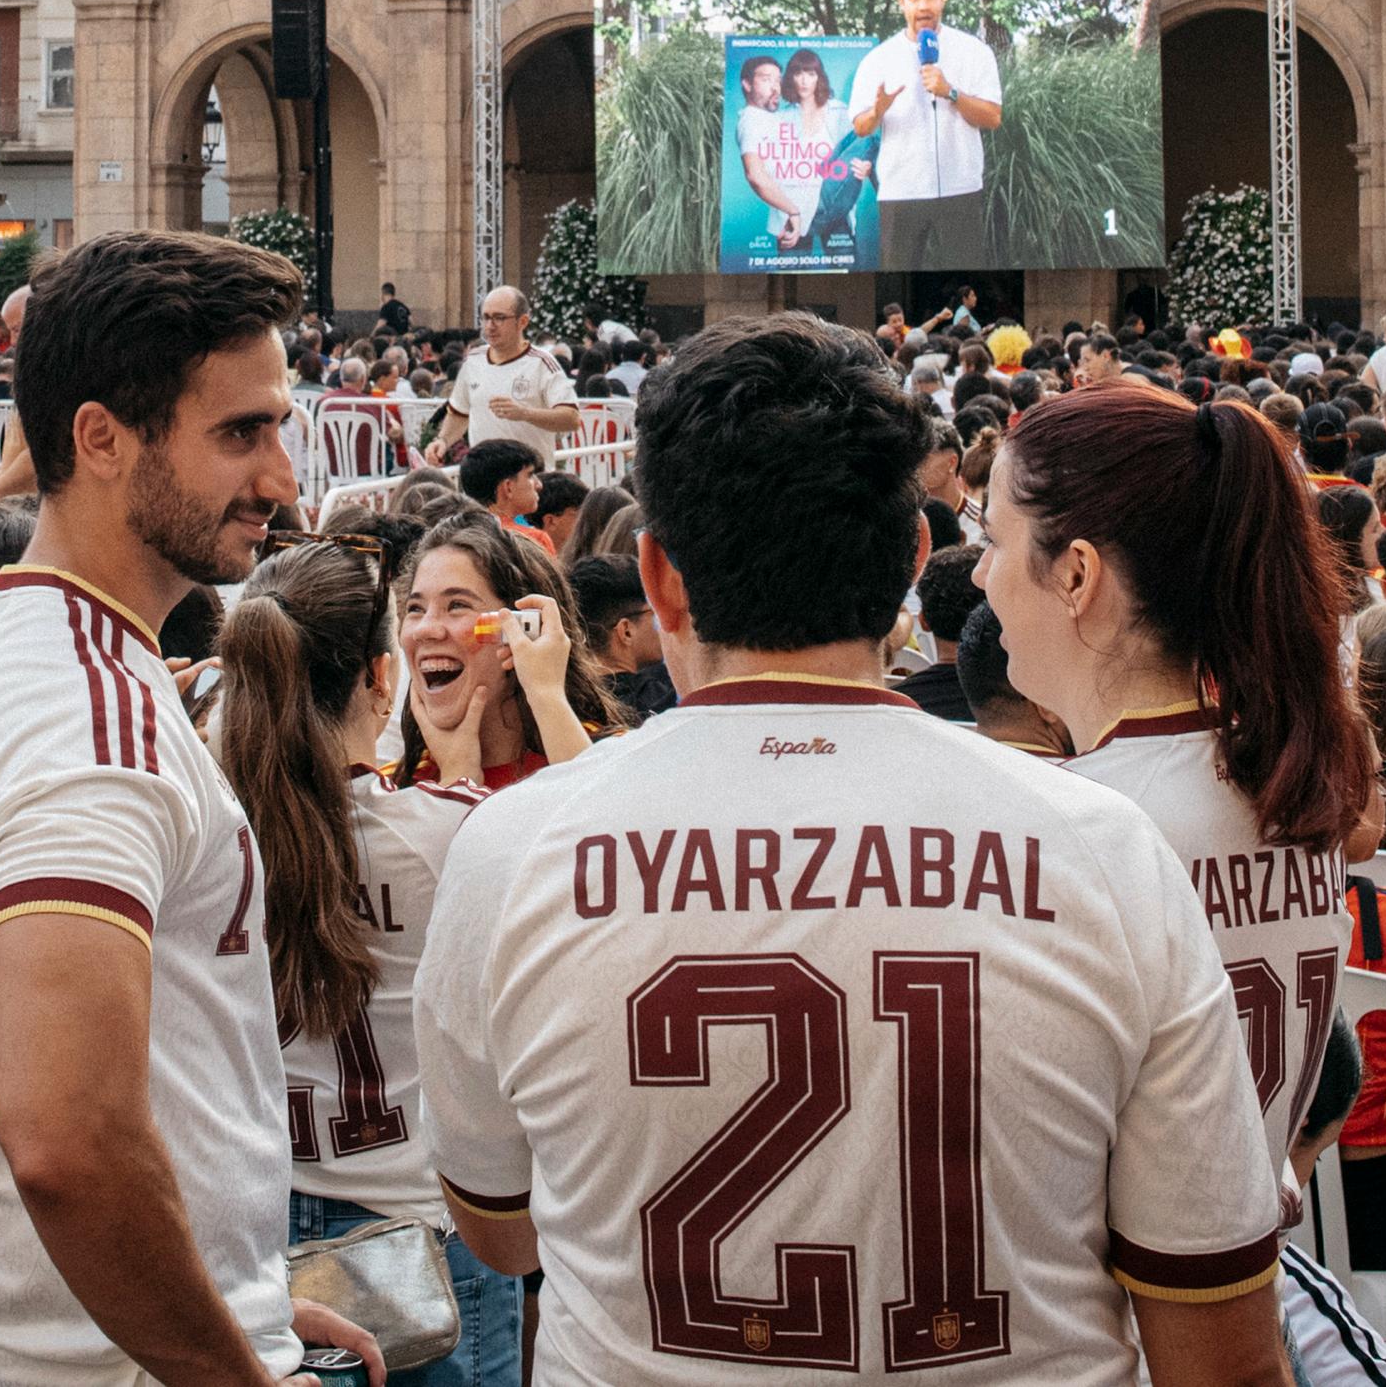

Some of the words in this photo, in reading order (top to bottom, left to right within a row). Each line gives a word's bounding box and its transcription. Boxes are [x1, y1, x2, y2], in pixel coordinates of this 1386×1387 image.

[779, 123, 799, 141] EL
[757, 136, 833, 160] ÚLTIMO
[775, 160, 848, 181] MONO
[1103, 208, 1119, 236] 1
[758, 734, 838, 760] España
[573, 824, 1057, 924] OYARZABAL
[626, 950, 1012, 1374] 21
